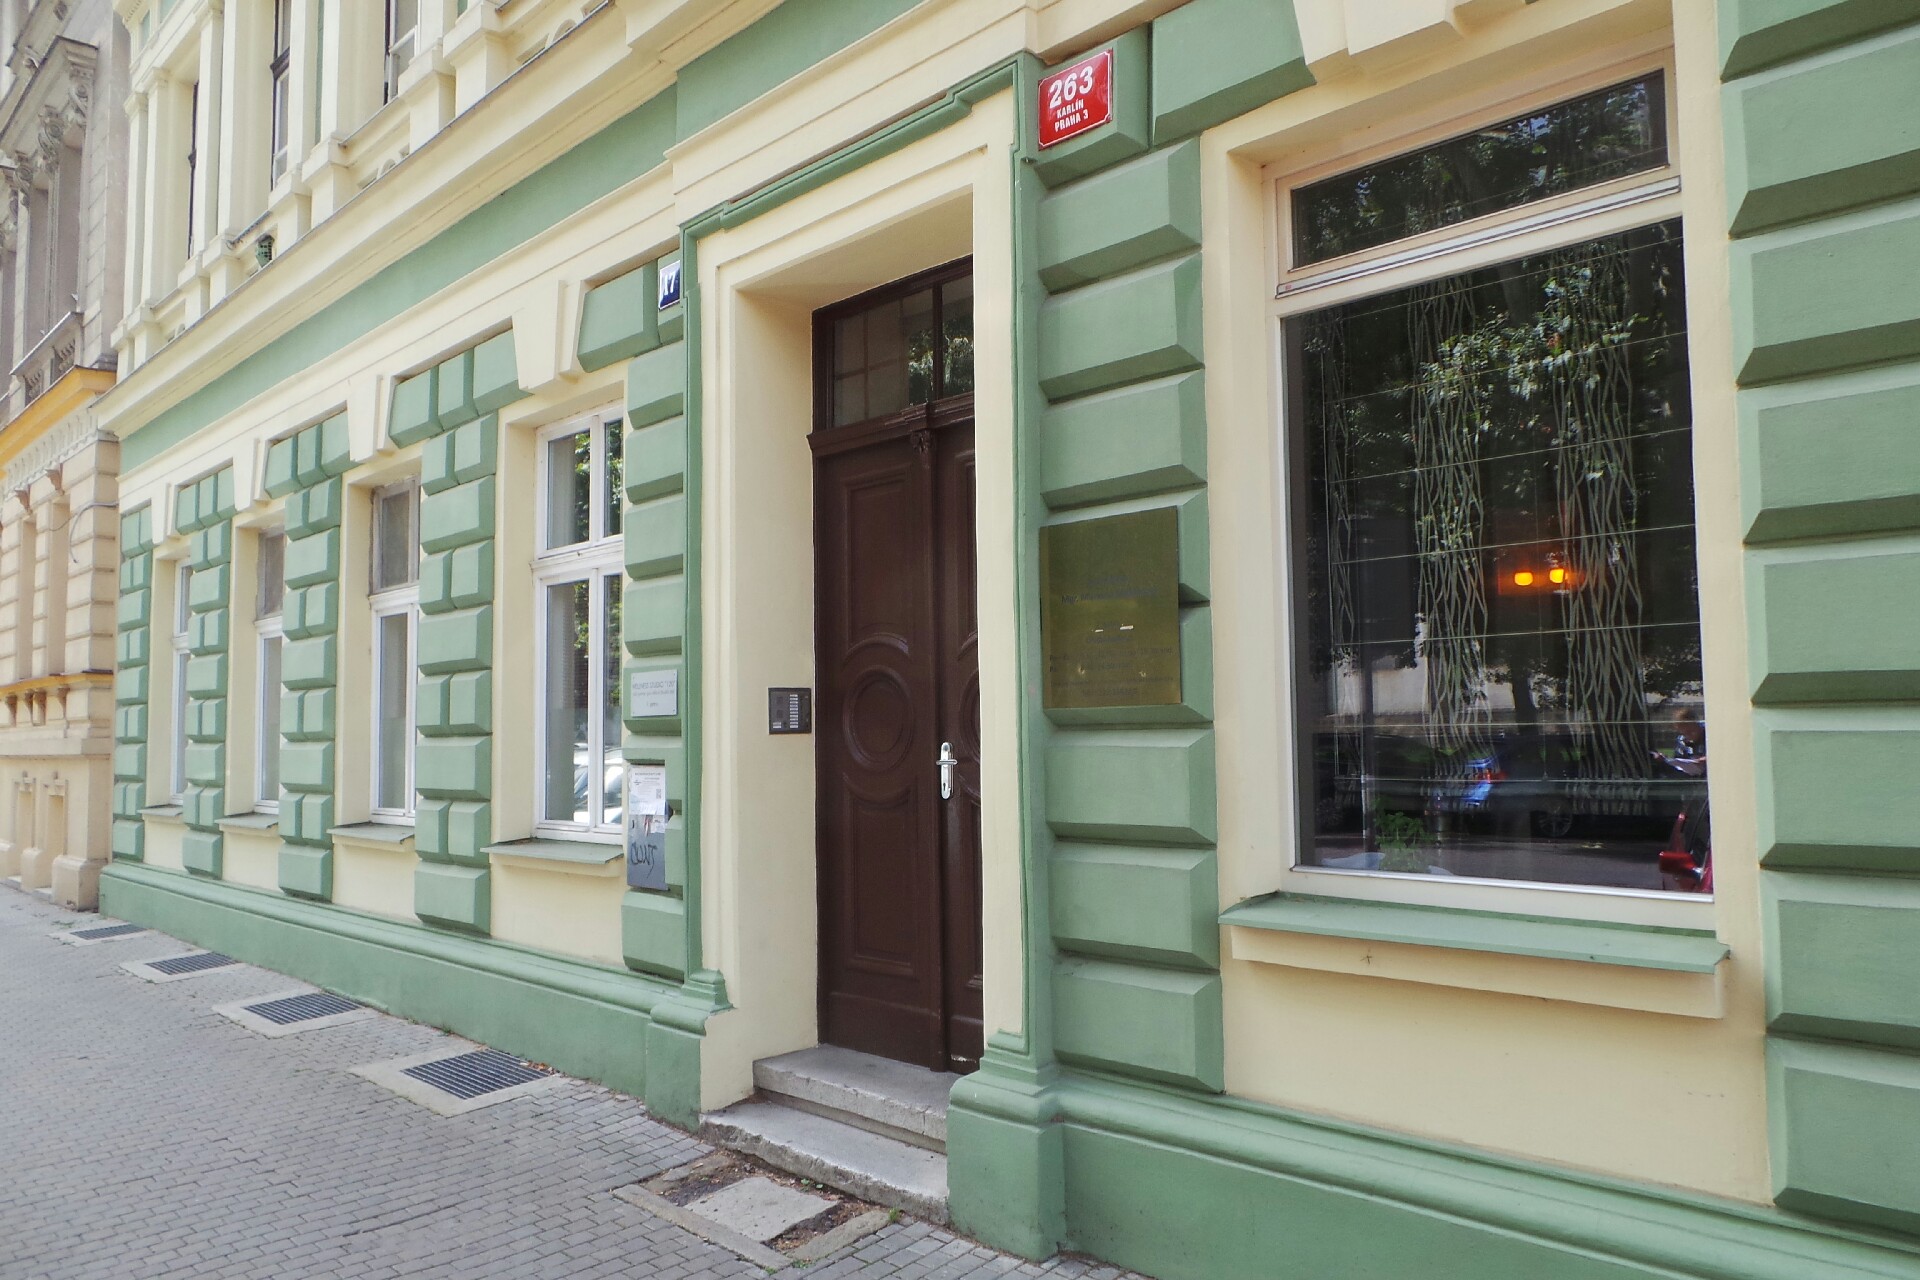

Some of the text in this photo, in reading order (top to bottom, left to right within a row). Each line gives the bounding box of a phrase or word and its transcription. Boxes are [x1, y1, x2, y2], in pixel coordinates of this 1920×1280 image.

[1049, 66, 1093, 108] 263
[1055, 109, 1088, 132] PRAHA 3
[664, 271, 676, 296] 17
